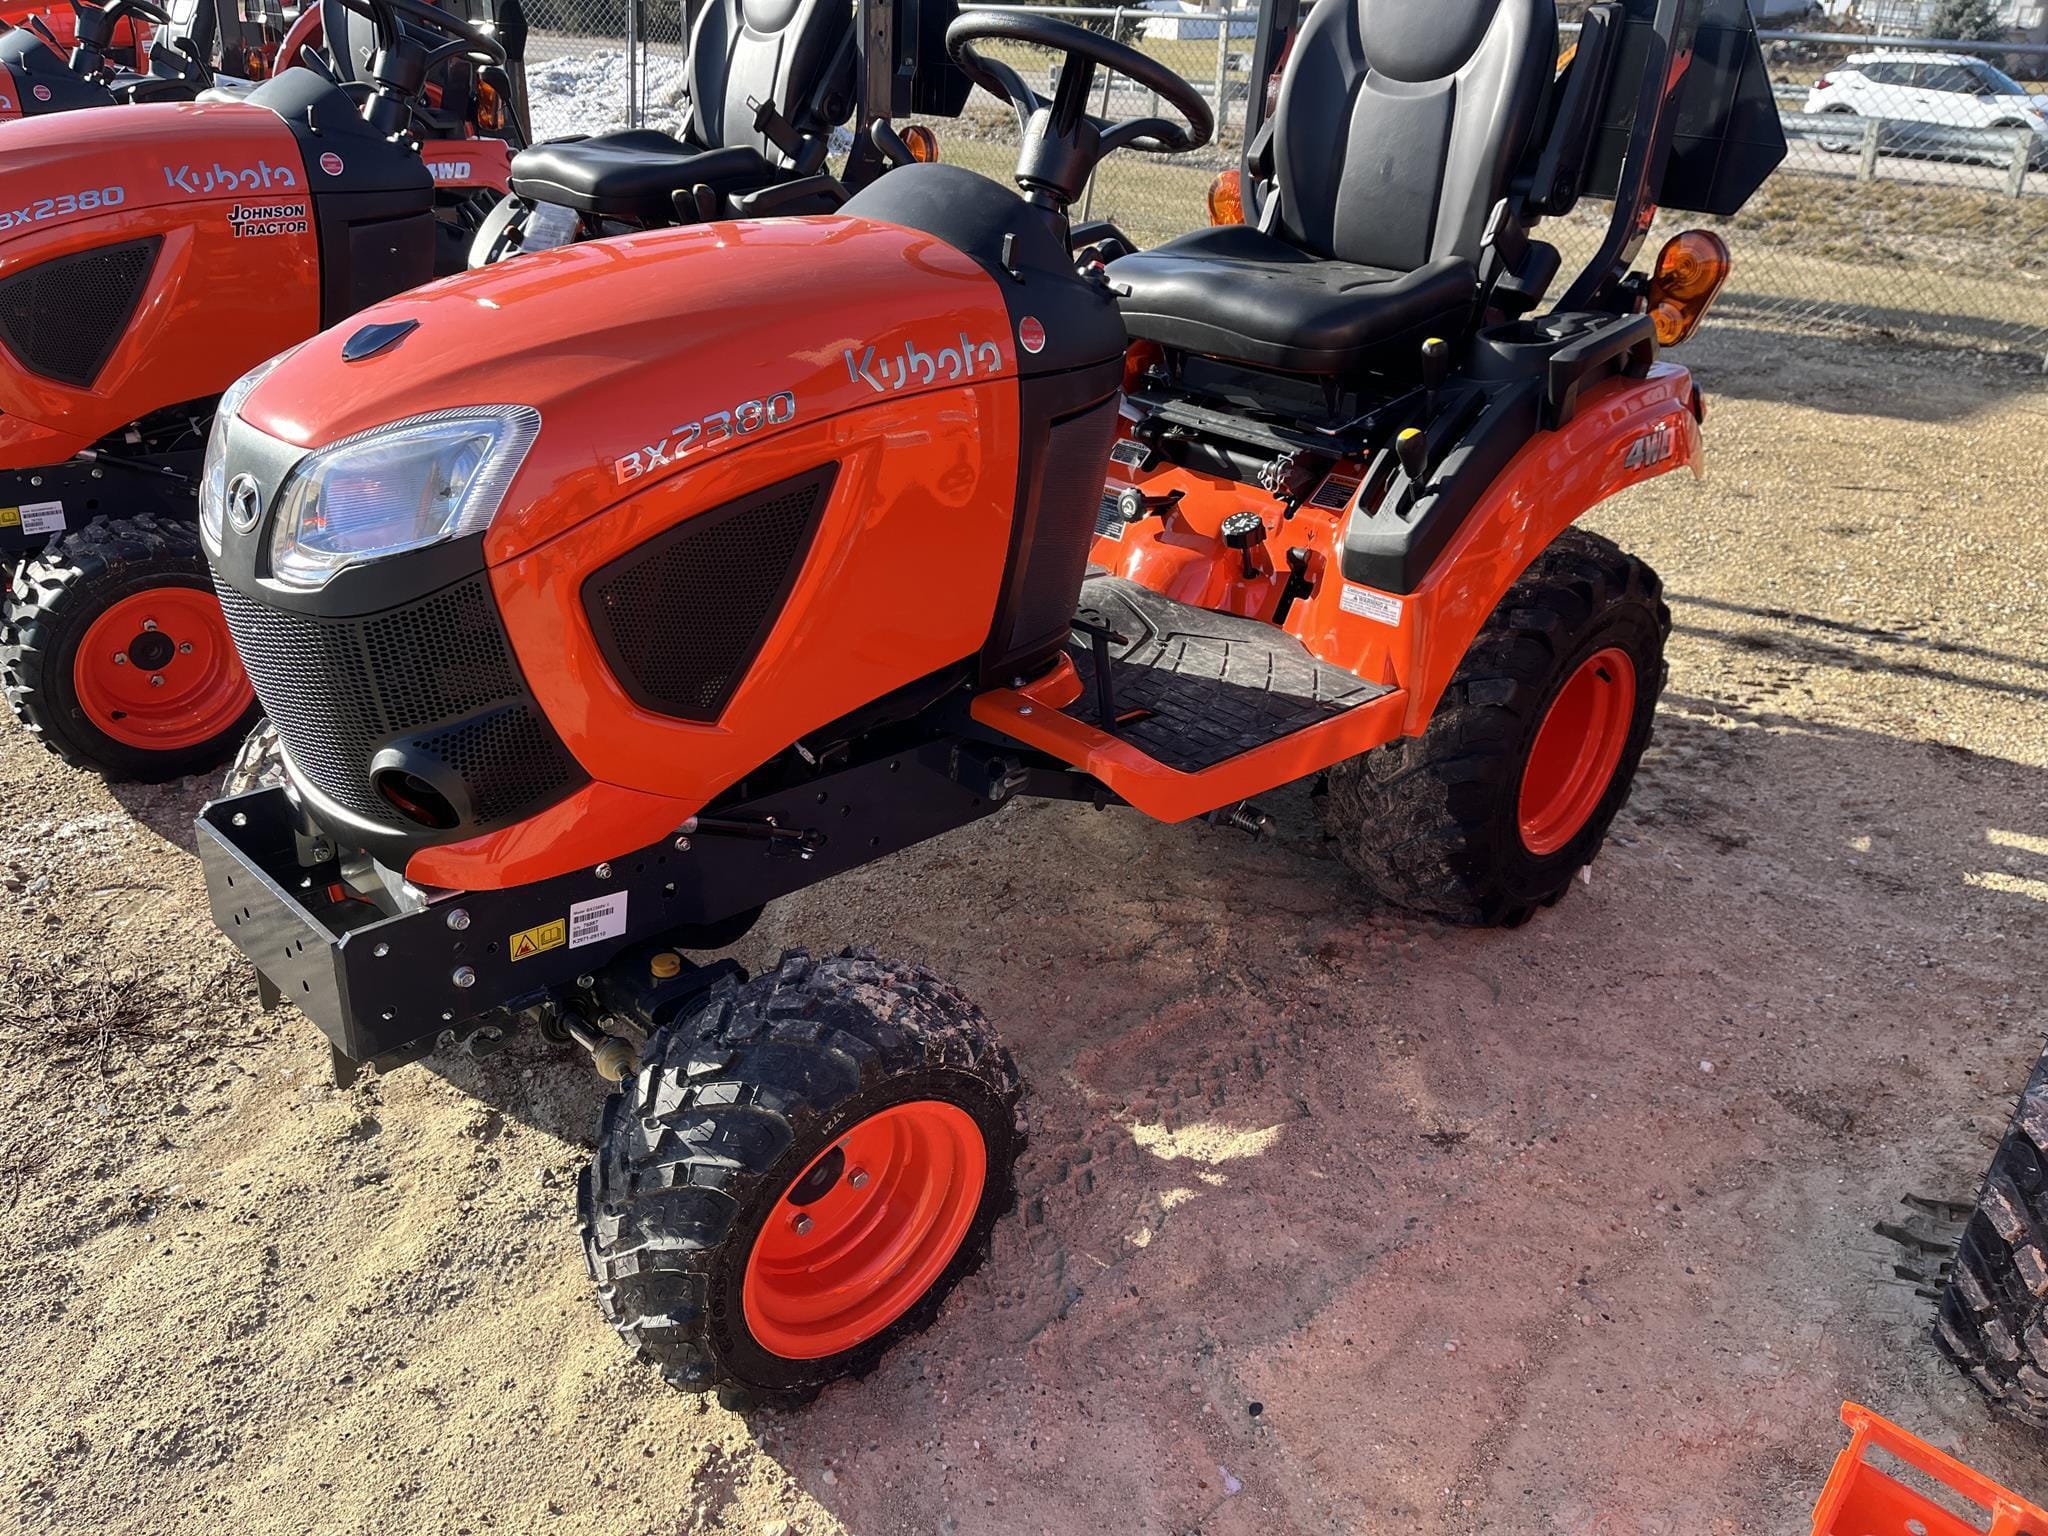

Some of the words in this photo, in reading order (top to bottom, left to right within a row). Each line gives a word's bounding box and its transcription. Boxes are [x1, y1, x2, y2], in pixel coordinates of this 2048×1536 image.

[164, 160, 296, 193] Kubota
[228, 204, 305, 222] JOHNSON
[231, 221, 308, 237] TRACTOR
[844, 332, 1002, 392] Kubota
[615, 390, 796, 486] BX2380
[1624, 427, 1676, 470] 4WD
